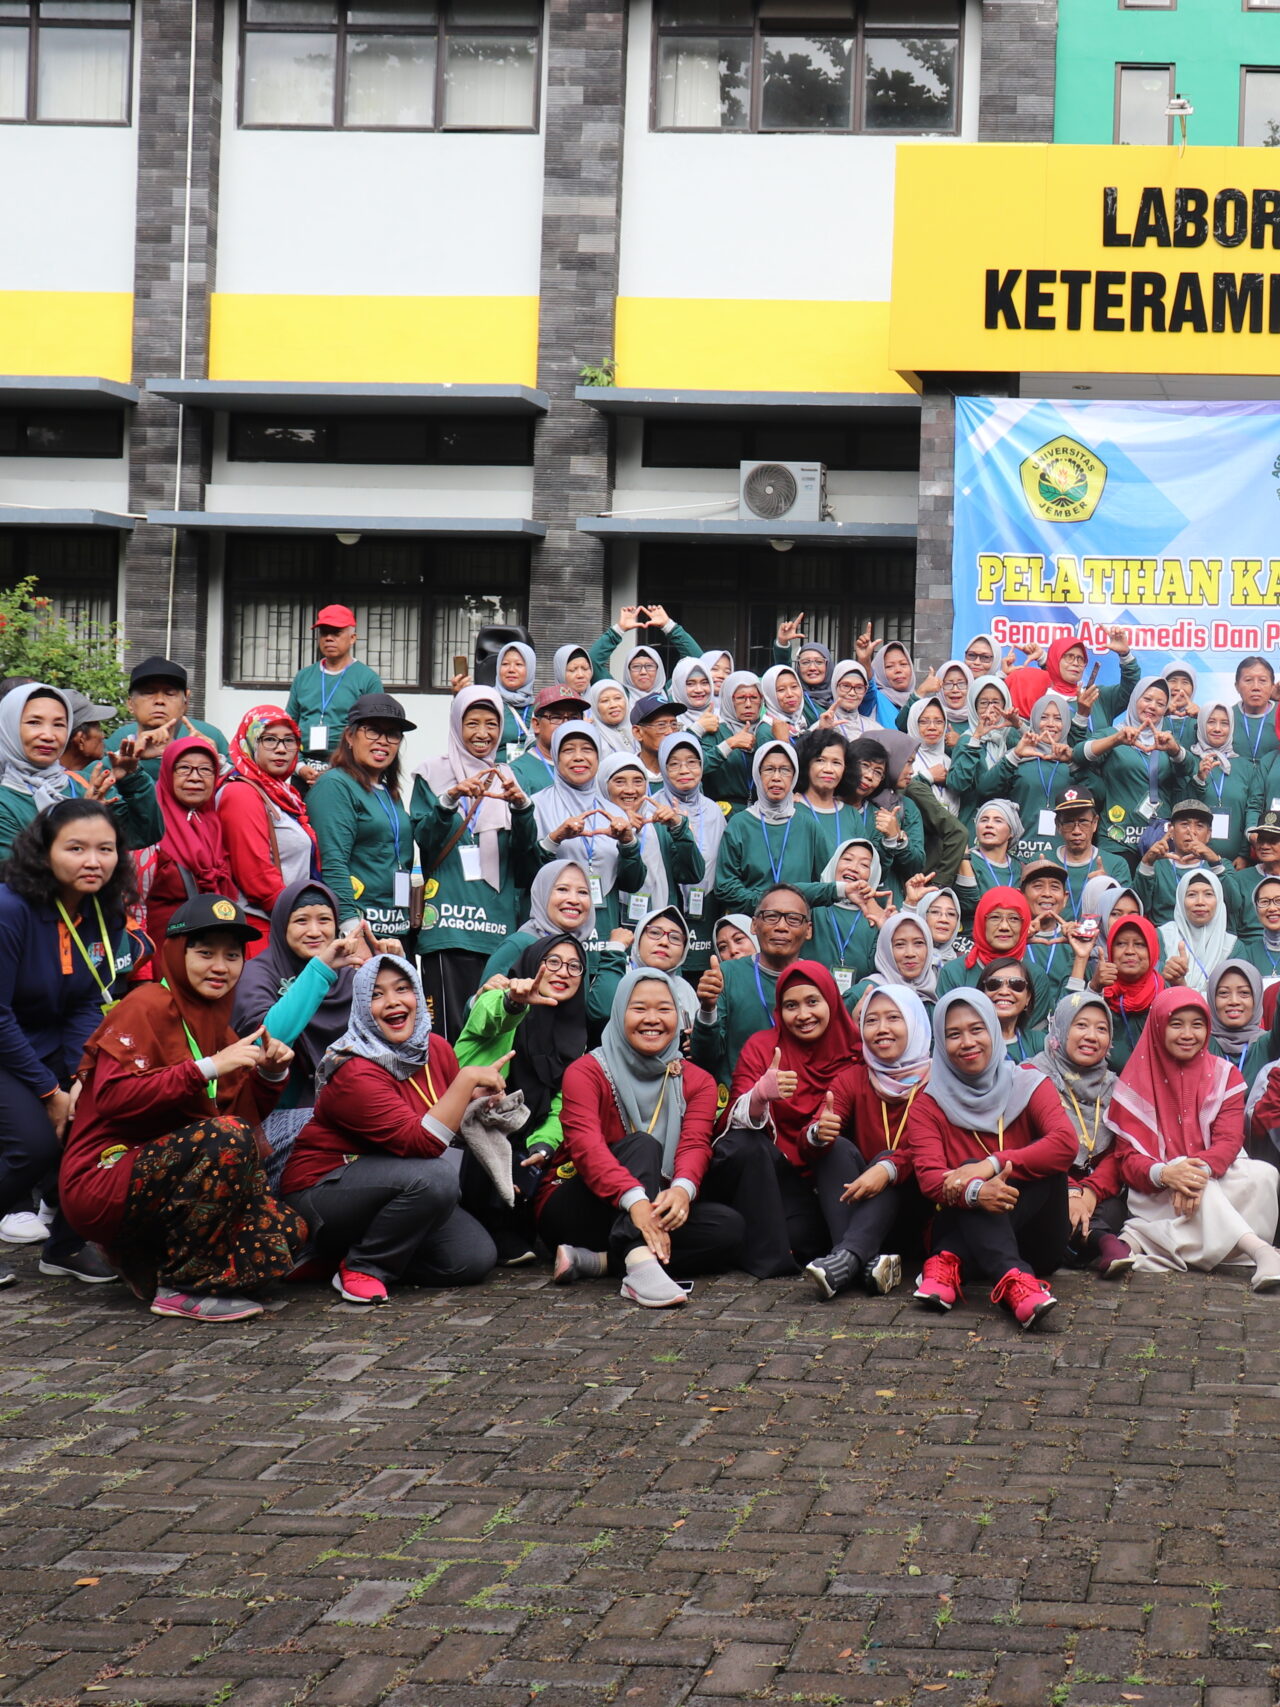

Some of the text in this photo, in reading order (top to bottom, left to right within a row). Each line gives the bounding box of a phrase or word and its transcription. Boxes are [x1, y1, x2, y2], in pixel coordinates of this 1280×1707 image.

[1032, 447, 1095, 472] UNIVERSITAS
[1039, 501, 1088, 518] JEMBER
[978, 555, 1222, 606] PELATIHAN
[993, 619, 1072, 647] Senam
[1080, 620, 1207, 653] Agomedis
[1214, 623, 1258, 650] Dan
[1018, 840, 1053, 851] DUTA
[366, 908, 405, 922] DUTA
[440, 903, 487, 921] DUTA
[438, 918, 507, 936] AGROMEDIS
